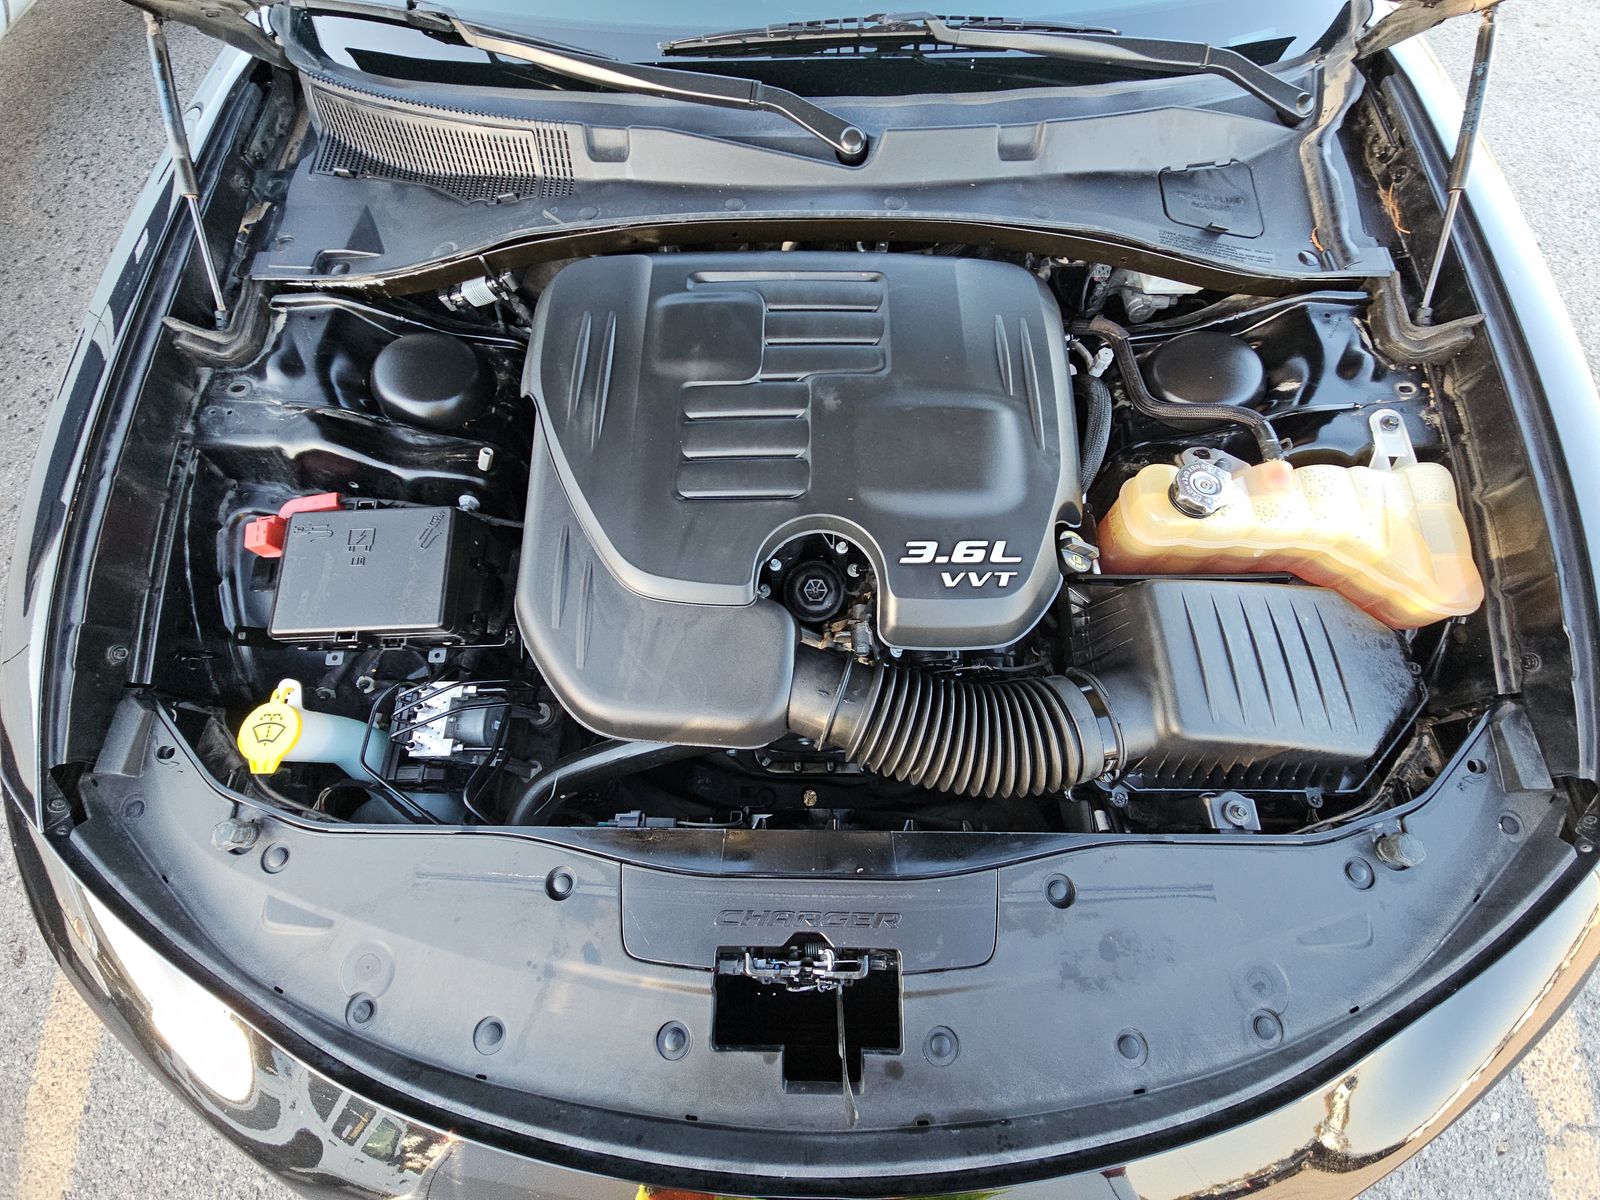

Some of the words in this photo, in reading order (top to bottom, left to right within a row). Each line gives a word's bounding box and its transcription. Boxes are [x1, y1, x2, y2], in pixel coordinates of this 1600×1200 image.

[899, 540, 1022, 564] 3.6L
[941, 571, 1018, 588] VVT
[713, 909, 903, 929] CHARGER
